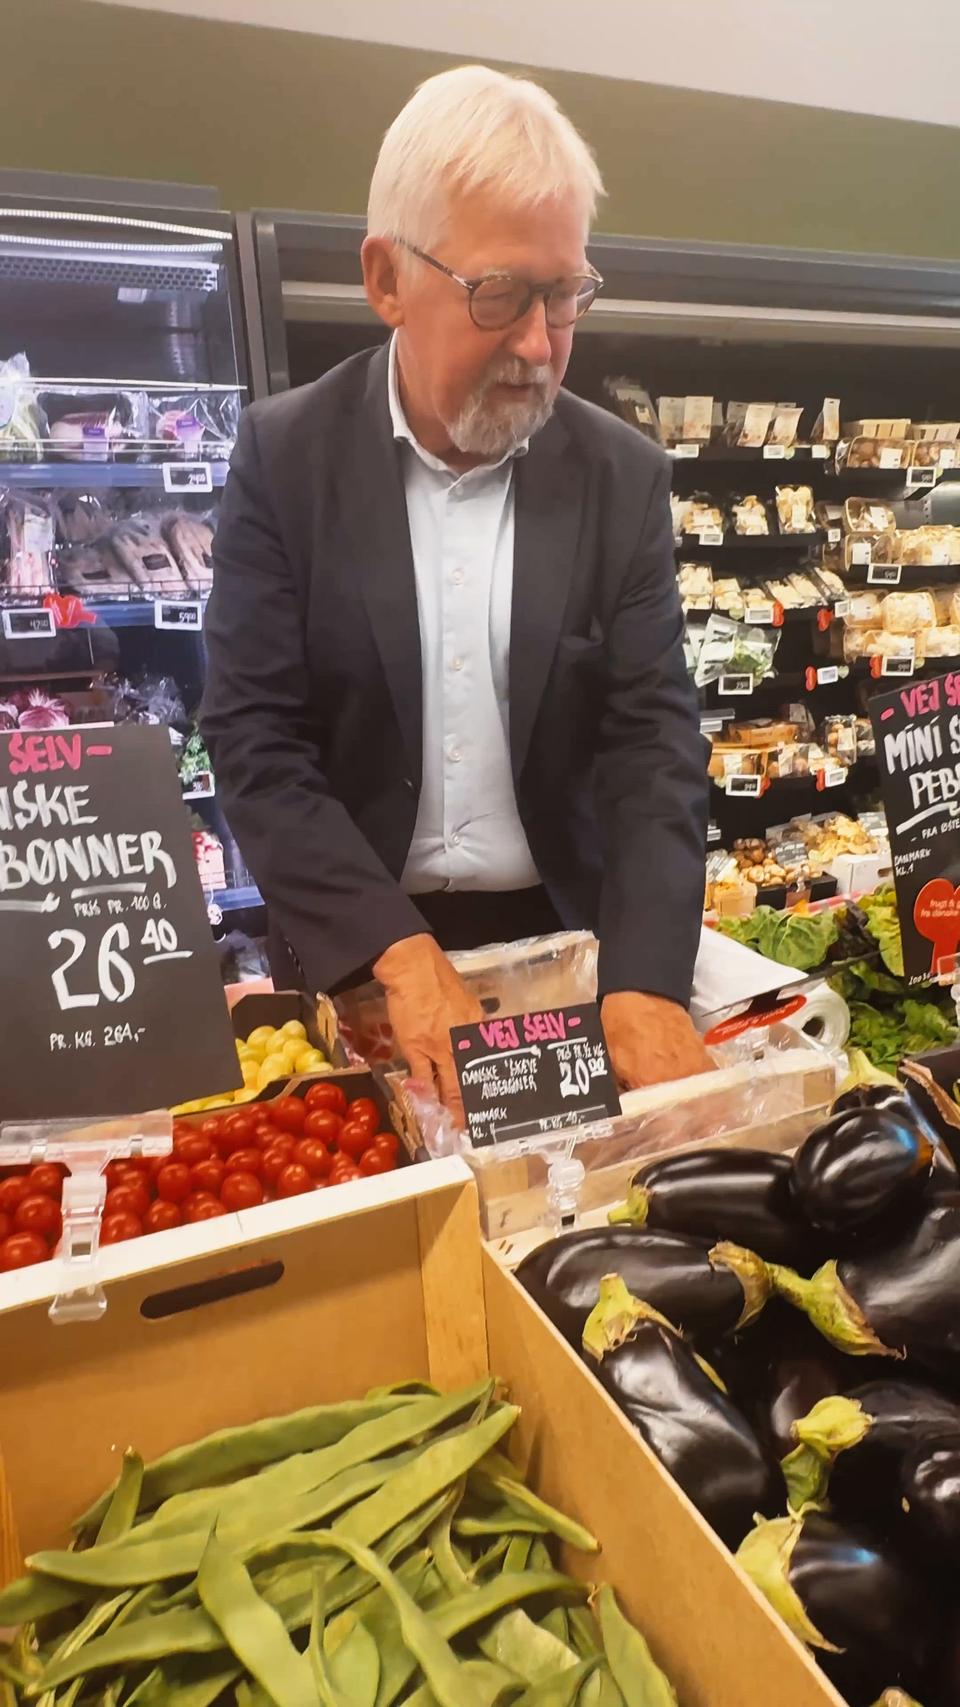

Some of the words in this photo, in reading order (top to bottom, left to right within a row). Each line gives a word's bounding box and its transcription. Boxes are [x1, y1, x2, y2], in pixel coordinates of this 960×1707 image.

[900, 680, 940, 718] VEJ
[909, 762, 960, 810] PEB
[922, 826, 938, 840] FRA
[479, 1018, 519, 1048] VEJ
[523, 1012, 567, 1043] SELV
[462, 1065, 499, 1086] DANSKE
